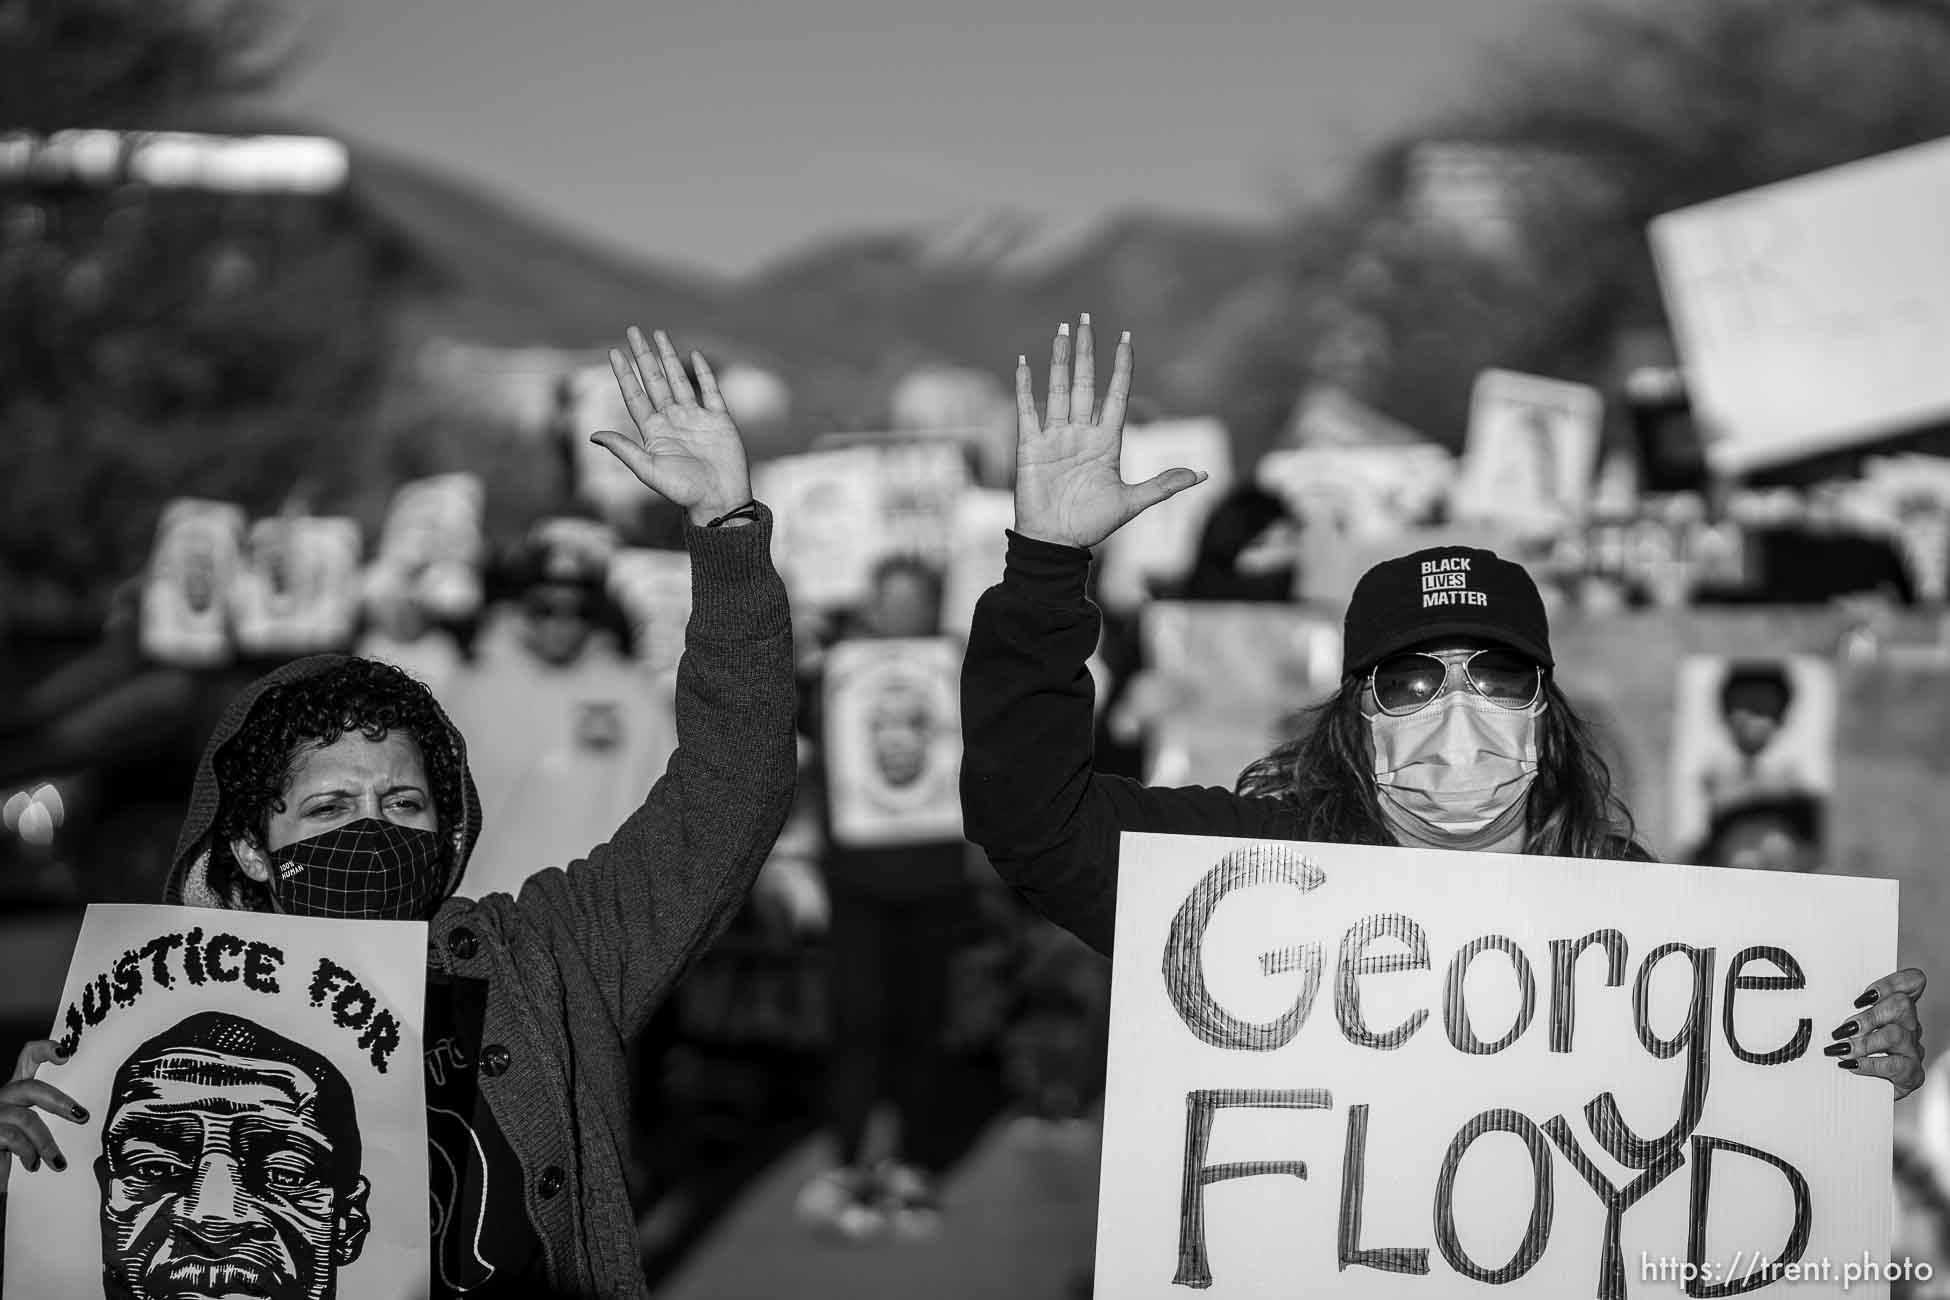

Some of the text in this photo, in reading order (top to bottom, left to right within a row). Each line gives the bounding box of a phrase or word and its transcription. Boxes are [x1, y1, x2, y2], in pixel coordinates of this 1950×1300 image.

[1421, 557, 1471, 575] BLACK
[1425, 573, 1464, 589] LIVES
[1423, 590, 1488, 608] MATTER
[281, 864, 304, 880] HUMAN
[1162, 844, 1812, 1168] George
[308, 957, 401, 1074] FOR
[1171, 1088, 1812, 1300] FLOYD
